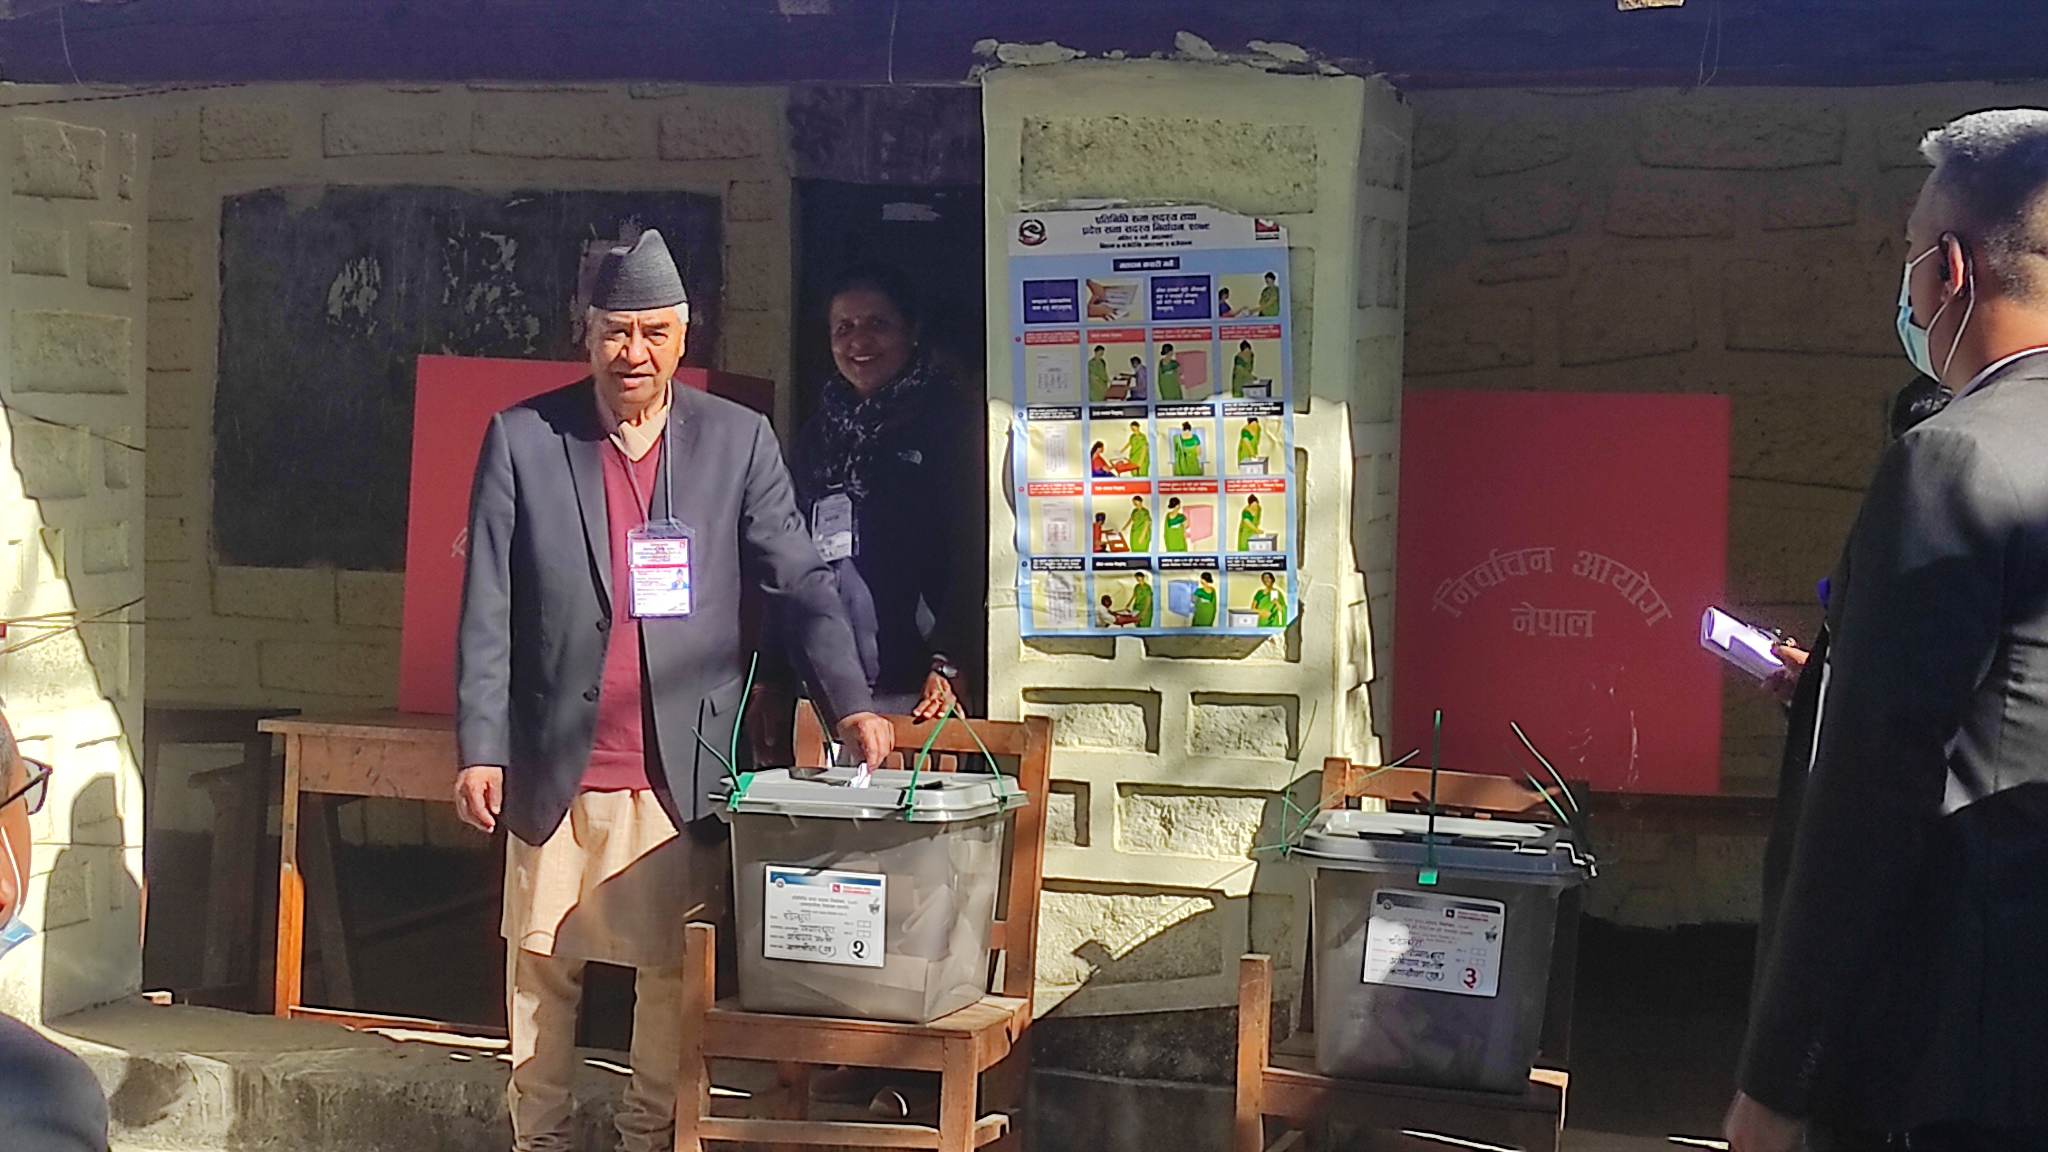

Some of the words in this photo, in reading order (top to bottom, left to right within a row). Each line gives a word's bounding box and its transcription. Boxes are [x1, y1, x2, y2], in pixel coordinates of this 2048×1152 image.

[1572, 550, 1672, 627] आयोग
[1510, 601, 1596, 638] नेपाल
[852, 940, 866, 959] २
[1463, 967, 1478, 989] ३
